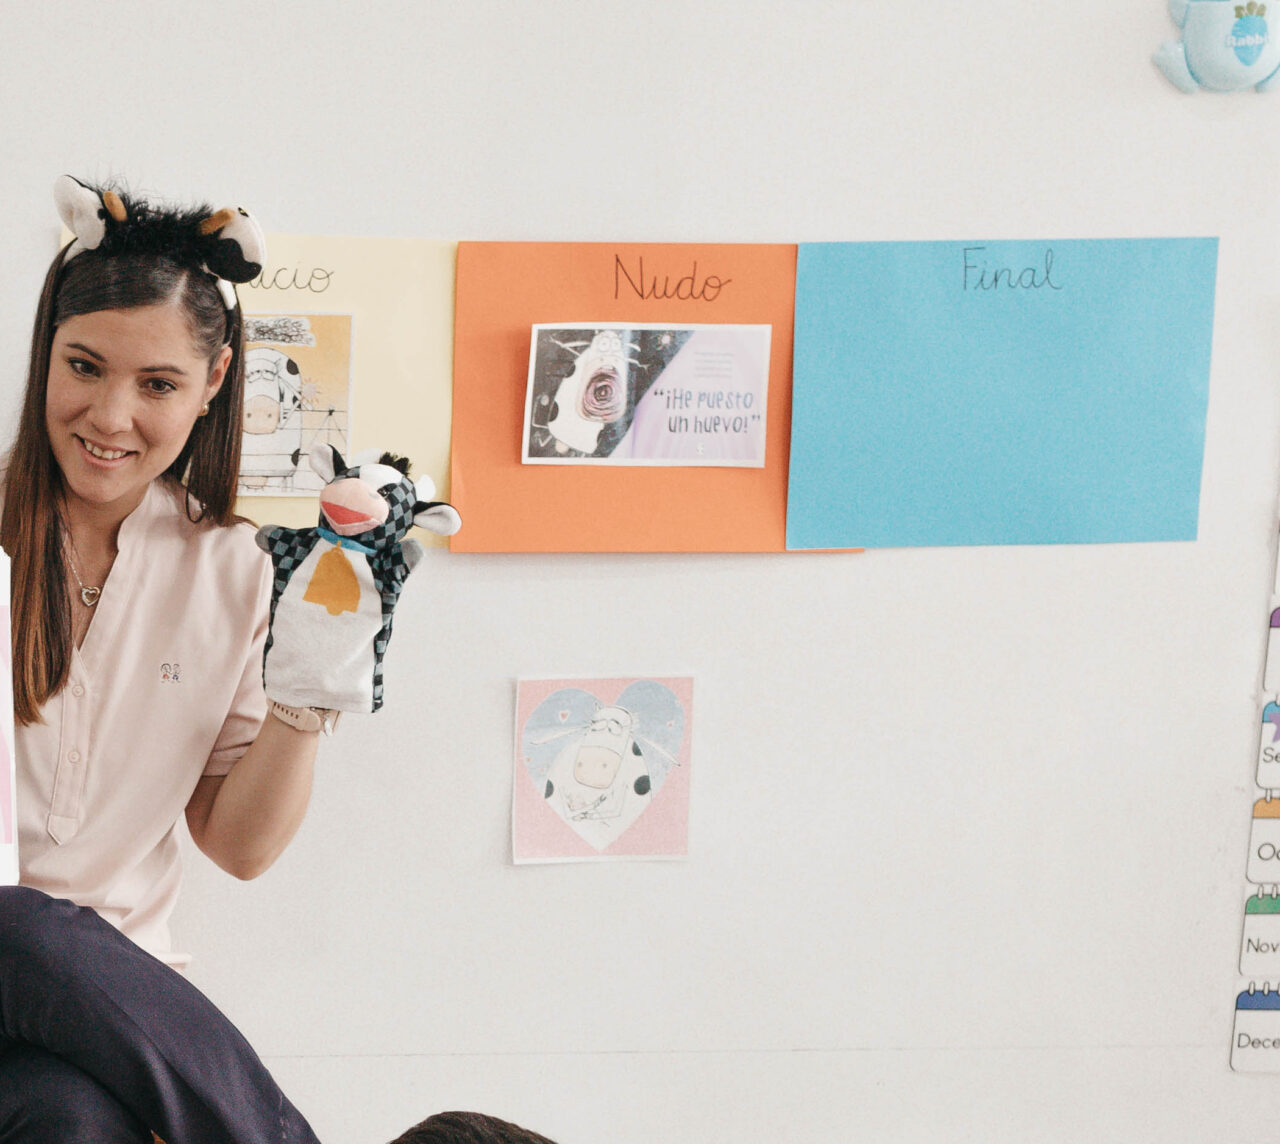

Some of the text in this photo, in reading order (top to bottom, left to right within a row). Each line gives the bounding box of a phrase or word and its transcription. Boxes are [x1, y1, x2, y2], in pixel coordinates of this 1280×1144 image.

[613, 254, 732, 302] Nudo
[963, 247, 1062, 290] Final
[668, 415, 689, 433] un
